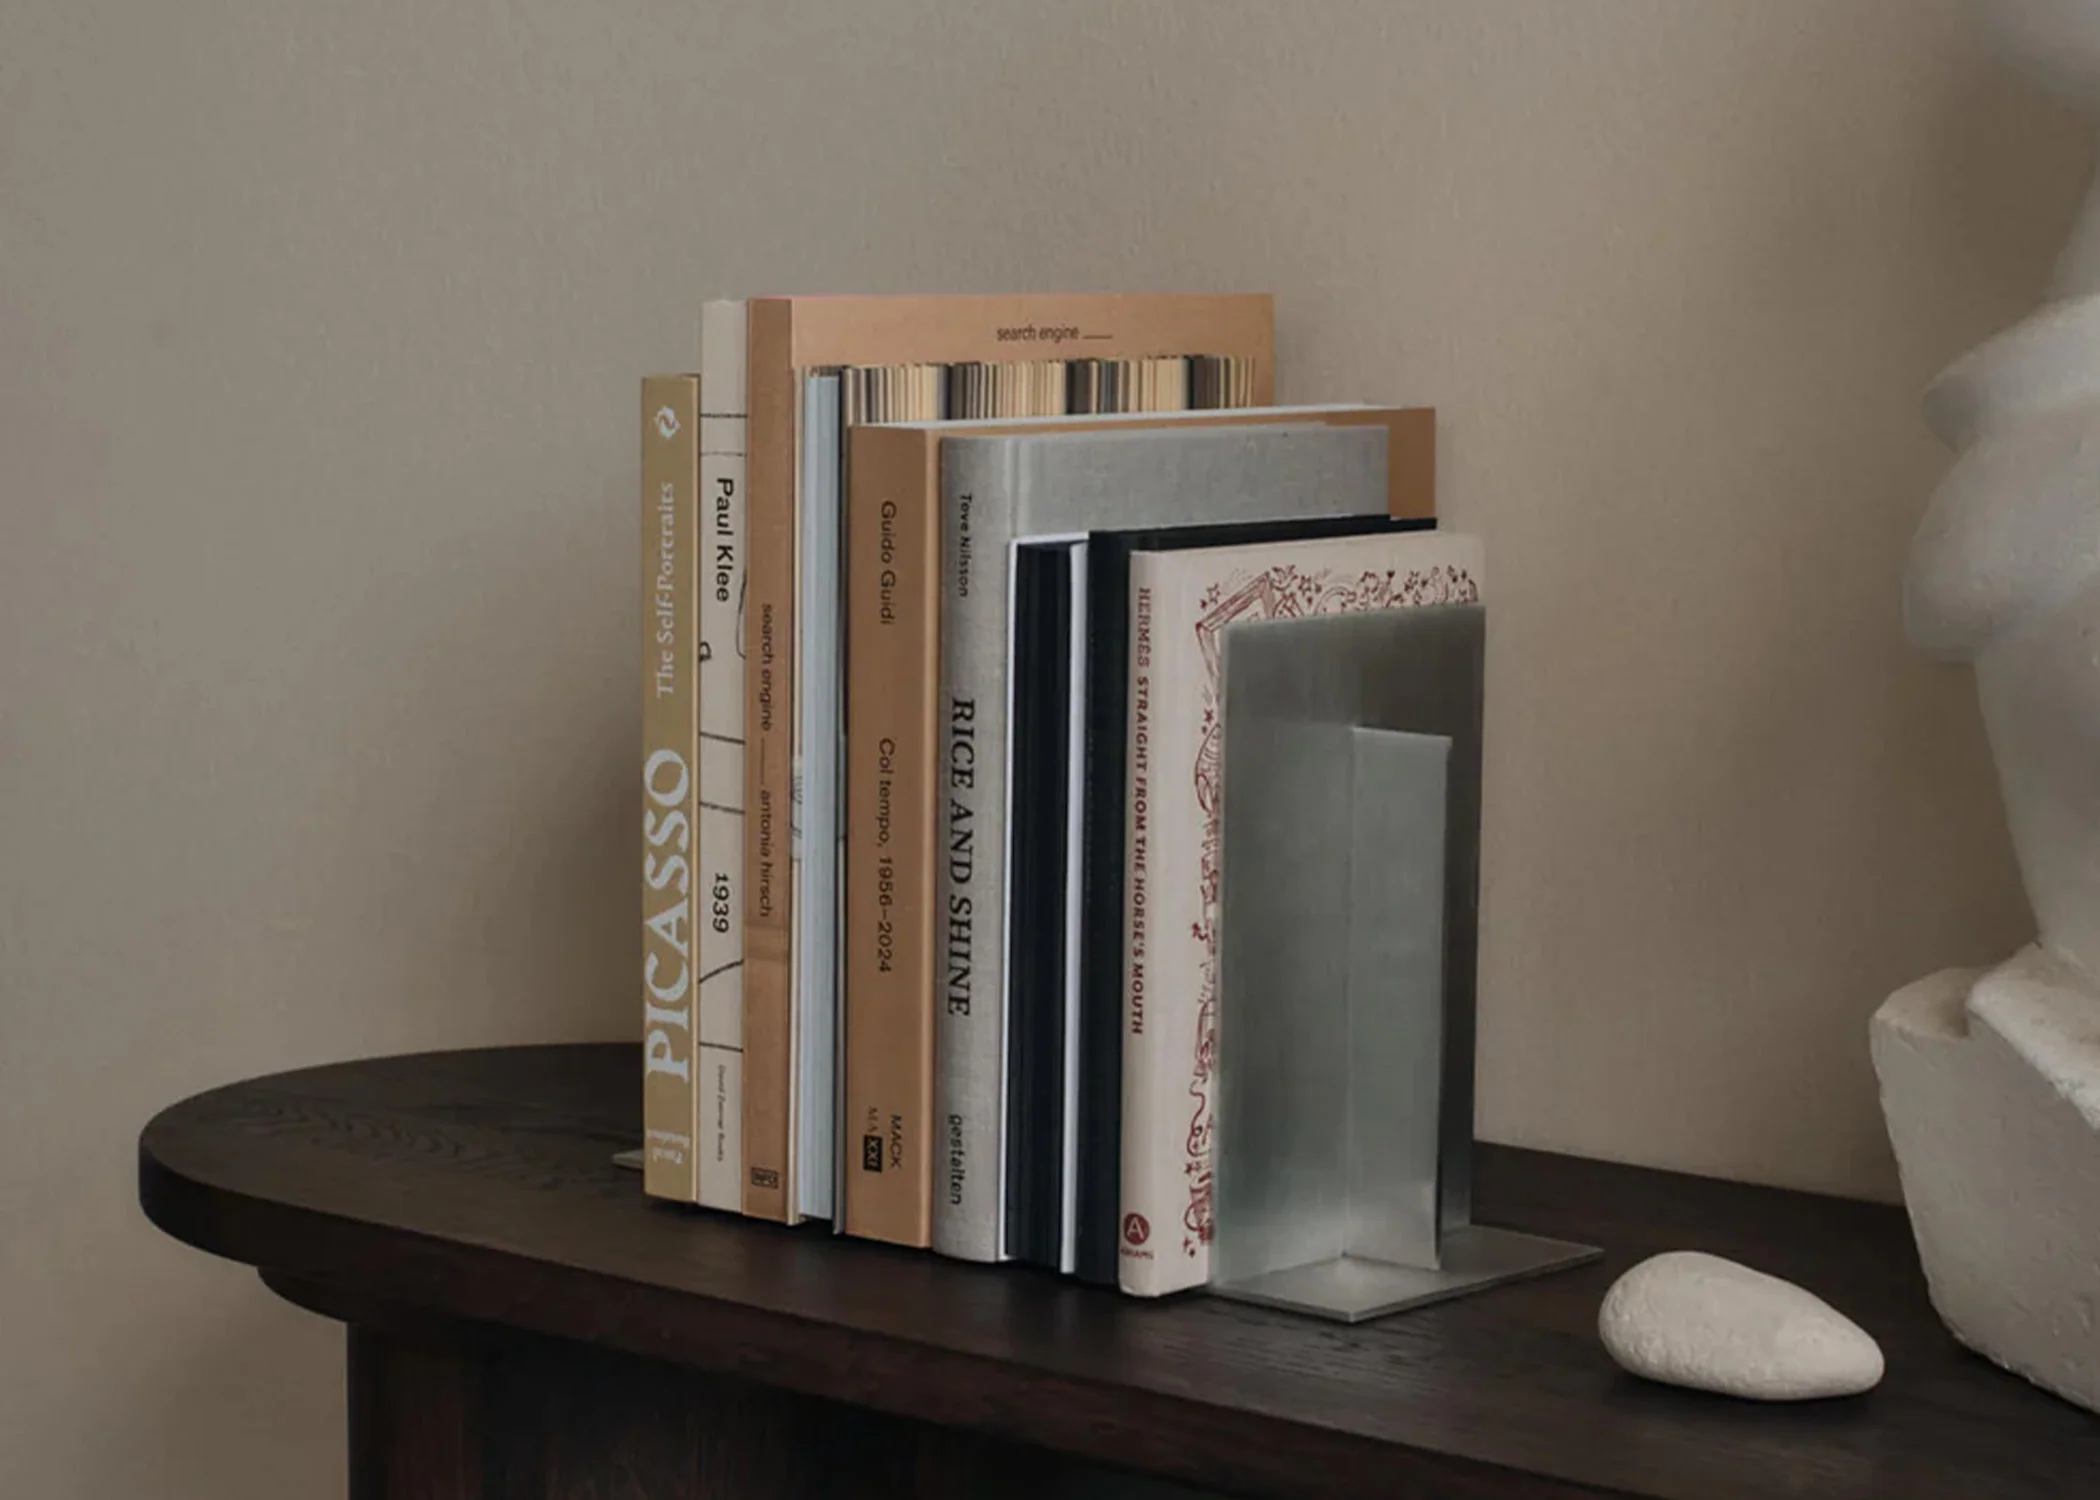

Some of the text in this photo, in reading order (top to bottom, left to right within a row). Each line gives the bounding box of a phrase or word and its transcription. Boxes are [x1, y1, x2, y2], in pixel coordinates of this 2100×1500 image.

[716, 478, 734, 602] Paul Klee
[880, 500, 896, 625] Guido Guidi
[958, 493, 972, 597] Tove Nilsson
[657, 651, 674, 698] The
[760, 604, 774, 730] search engine
[878, 738, 895, 774] Col
[1136, 676, 1148, 772] STRAIGHT
[876, 780, 894, 847] tempo,
[1134, 779, 1147, 831] FROM
[760, 790, 774, 917] antonia hirsch
[947, 698, 975, 1017] RICE AND SHINE
[1133, 838, 1146, 872] THE
[644, 749, 689, 1084] PICASSO
[713, 873, 729, 933] 1939
[1132, 878, 1145, 958] HORSE'S
[1132, 963, 1143, 1034] MOUTH
[891, 1114, 902, 1169] MACK
[949, 1114, 965, 1205] gestalten
